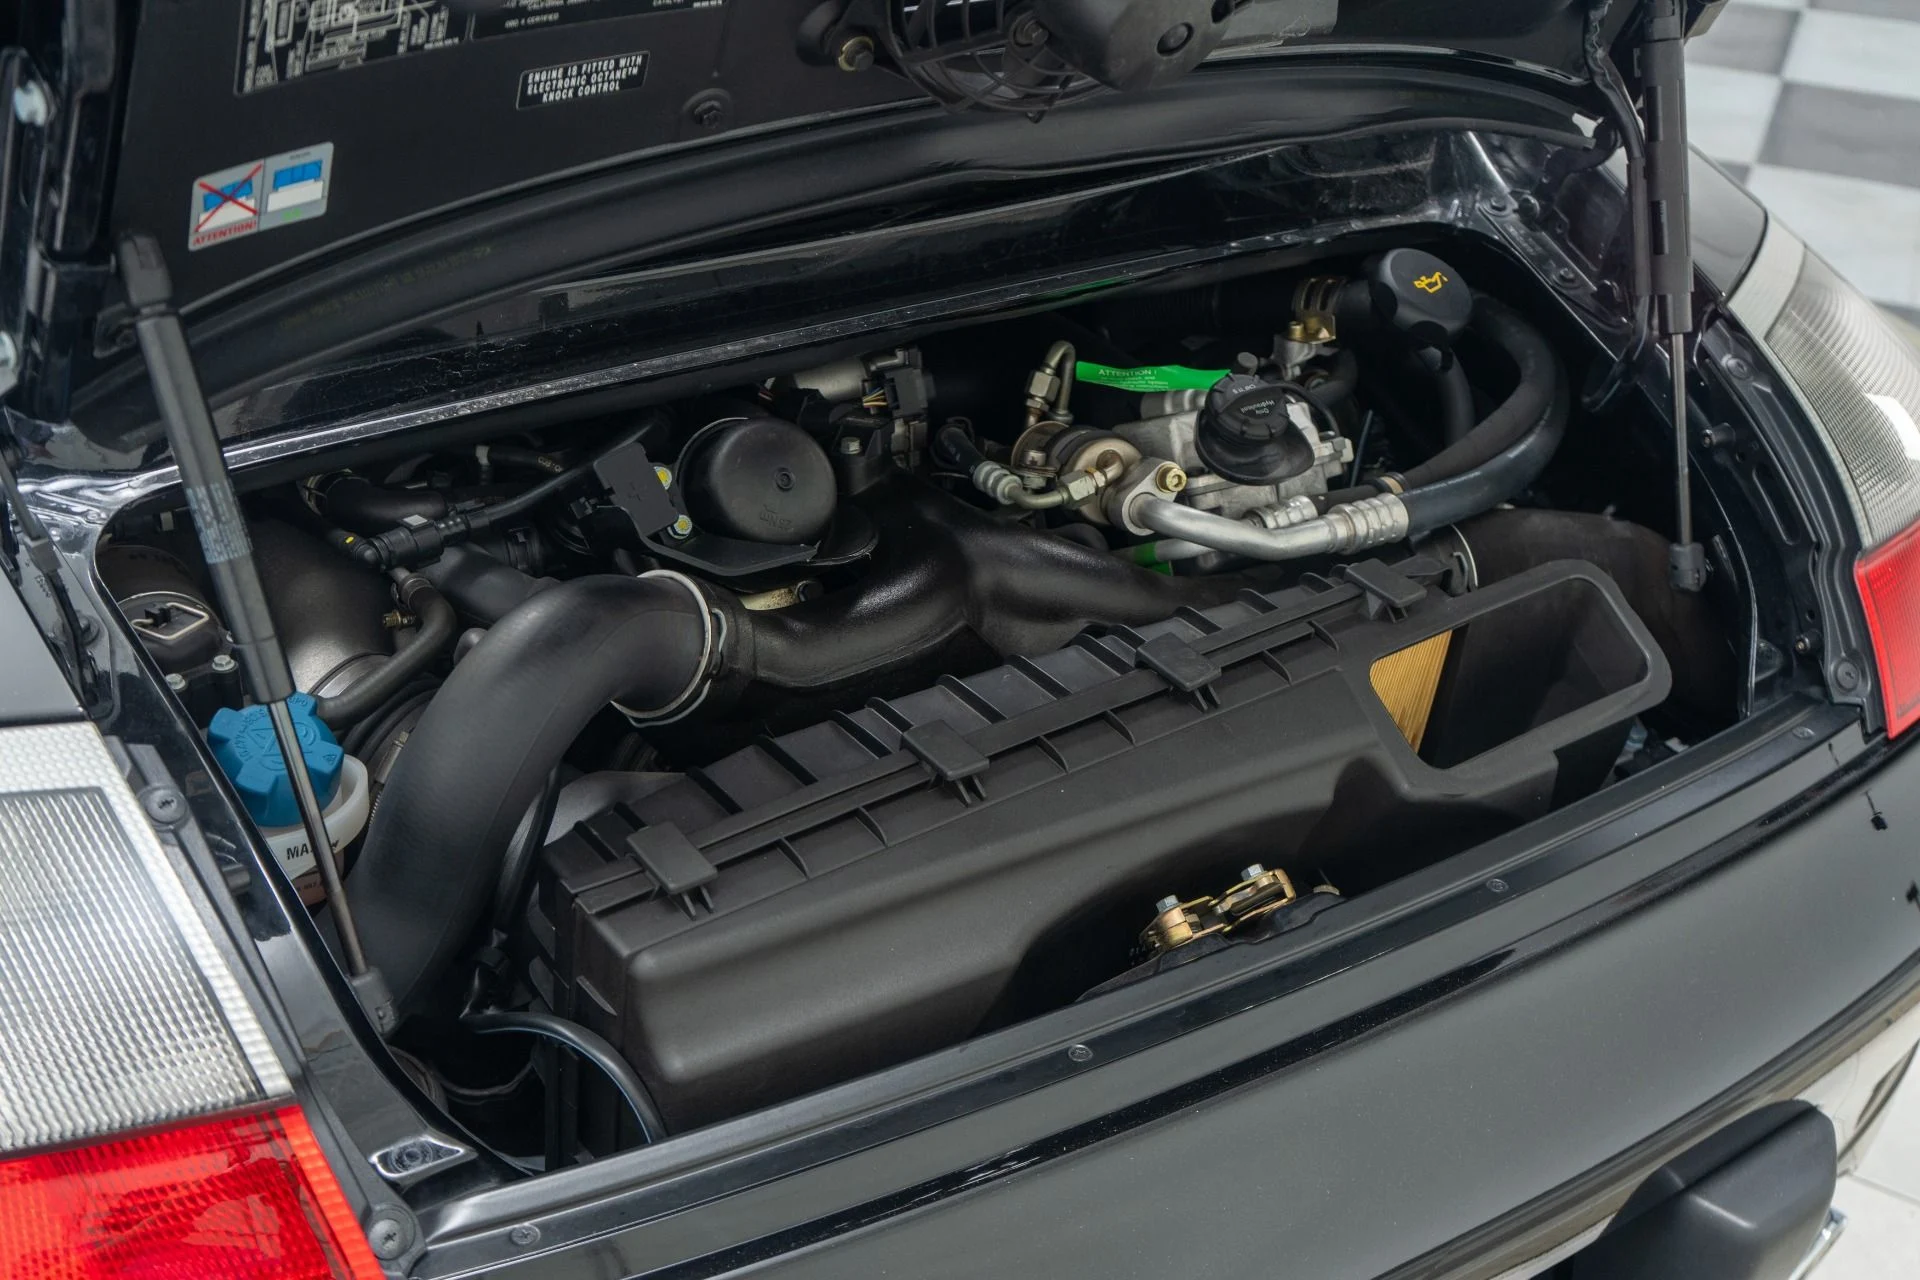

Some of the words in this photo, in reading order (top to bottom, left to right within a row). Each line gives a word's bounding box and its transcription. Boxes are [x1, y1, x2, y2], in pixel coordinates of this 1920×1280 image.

[527, 67, 564, 85] ENGINE
[567, 65, 578, 77] IS
[581, 59, 615, 75] FITTED
[619, 55, 643, 68] WITH
[527, 75, 587, 95] ELECTRONIC
[542, 88, 575, 104] KNOCK
[577, 81, 620, 97] CONTROL
[193, 220, 257, 246] ATTENTION!
[1098, 368, 1151, 377] ATTENTION
